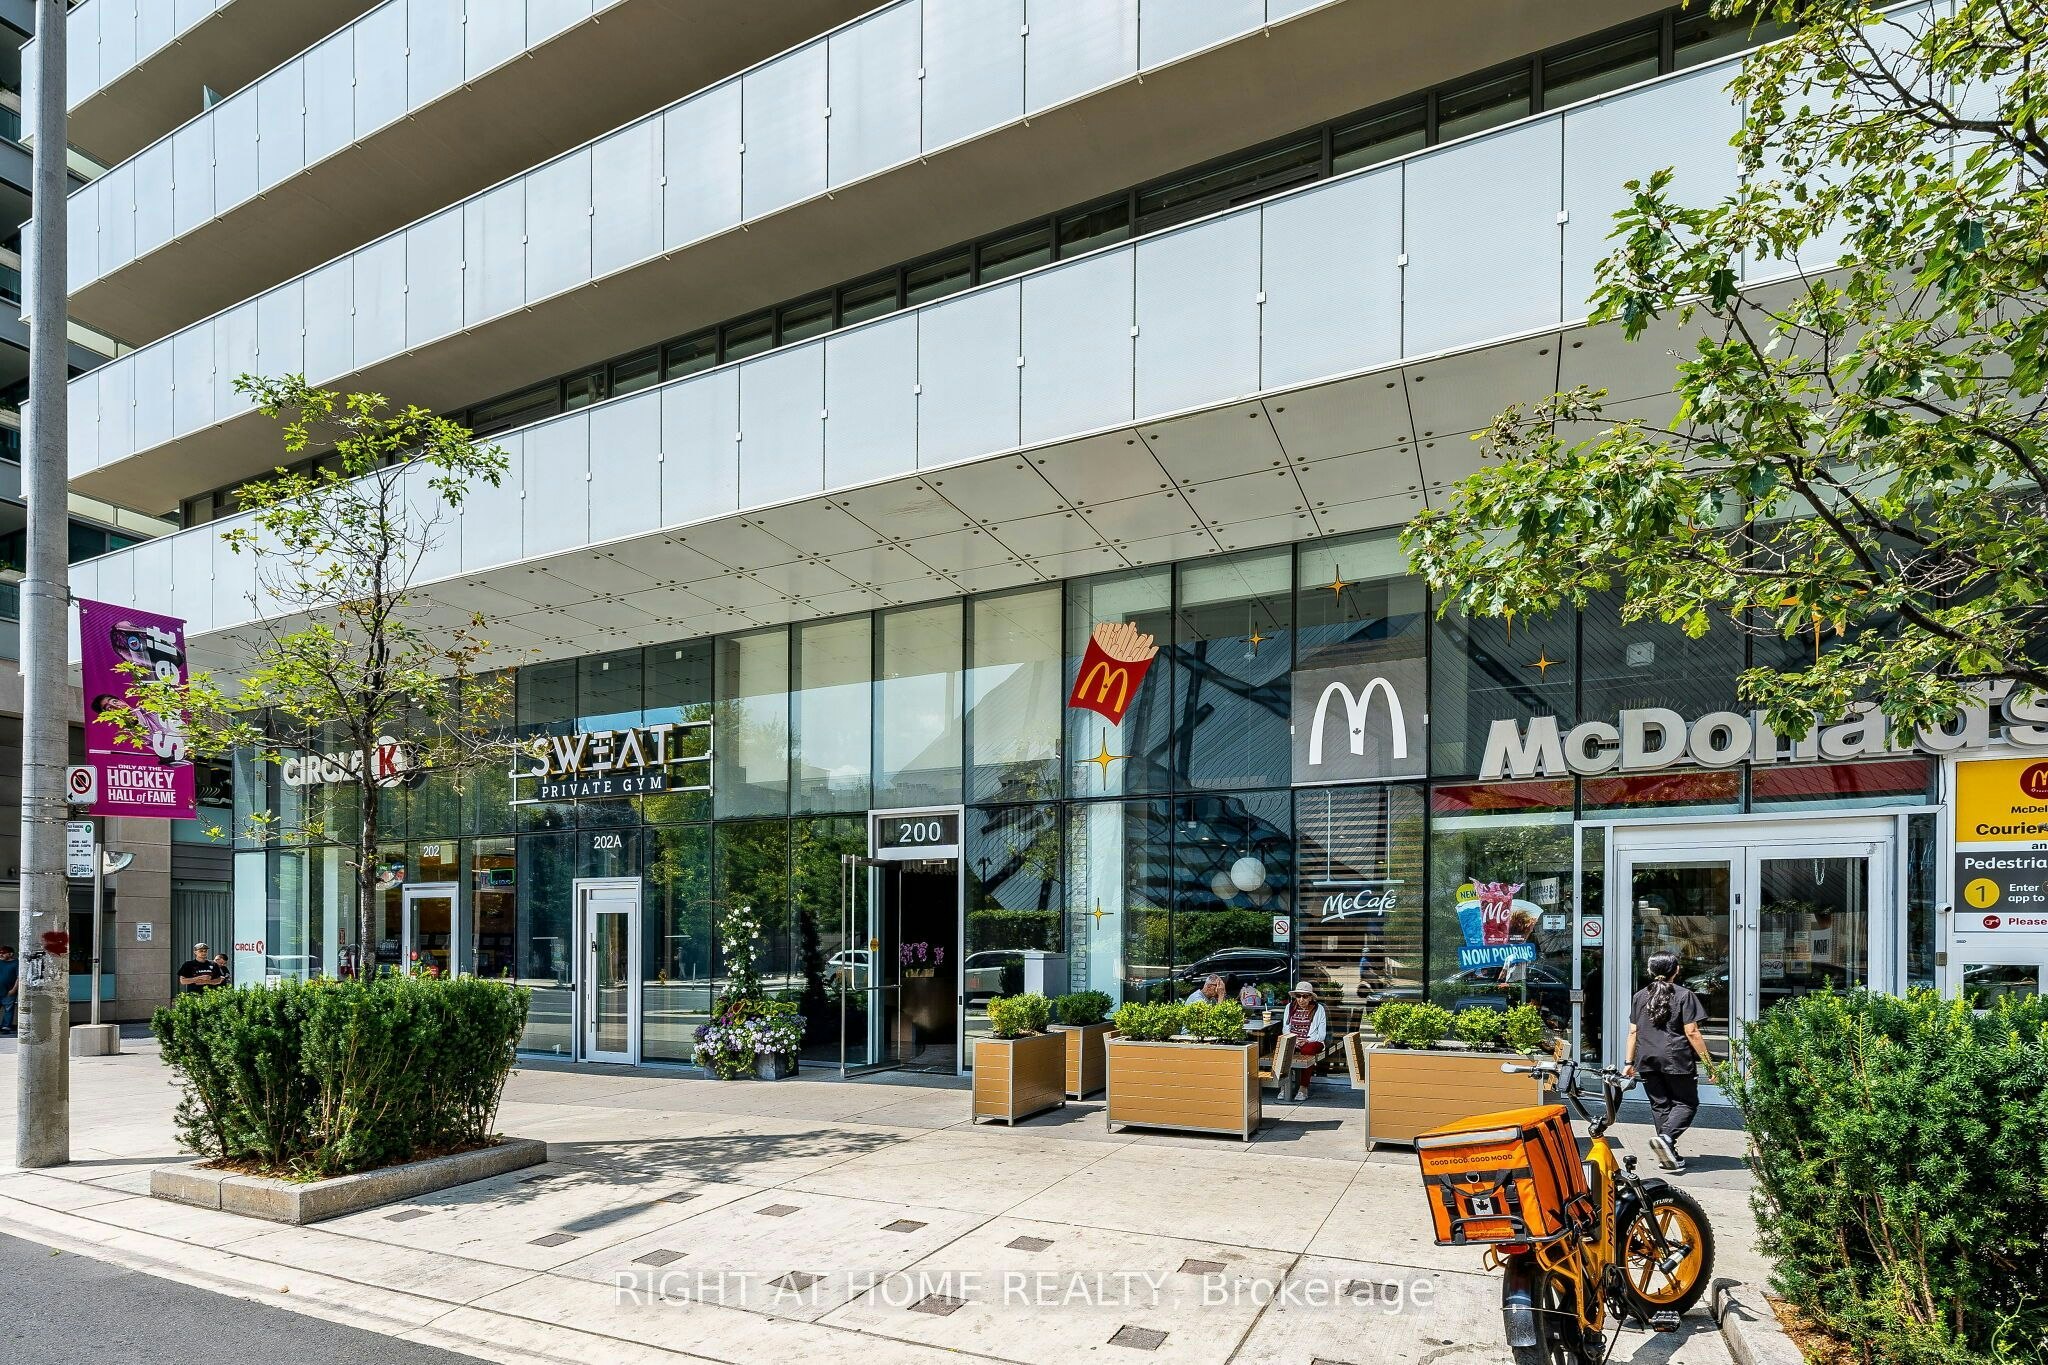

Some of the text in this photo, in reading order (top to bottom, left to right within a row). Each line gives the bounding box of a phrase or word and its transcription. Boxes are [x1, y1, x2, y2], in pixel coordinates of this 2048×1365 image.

[531, 723, 675, 777] SWEAT
[107, 769, 175, 789] HOCKEY
[541, 776, 662, 799] PRIVATE GYM
[108, 789, 176, 803] HALL of FAME
[899, 822, 942, 843] 200
[593, 835, 622, 849] 202A
[423, 845, 440, 858] 202
[1964, 857, 2048, 870] Pedestria
[1460, 891, 1477, 899] NEW
[1975, 883, 2039, 902] 1 Enter
[2008, 894, 2045, 904] app to
[1322, 889, 1396, 917] McCafé
[2008, 917, 2048, 926] Please
[235, 943, 255, 952] CIRCLE
[1462, 945, 1534, 966] NOW POURING
